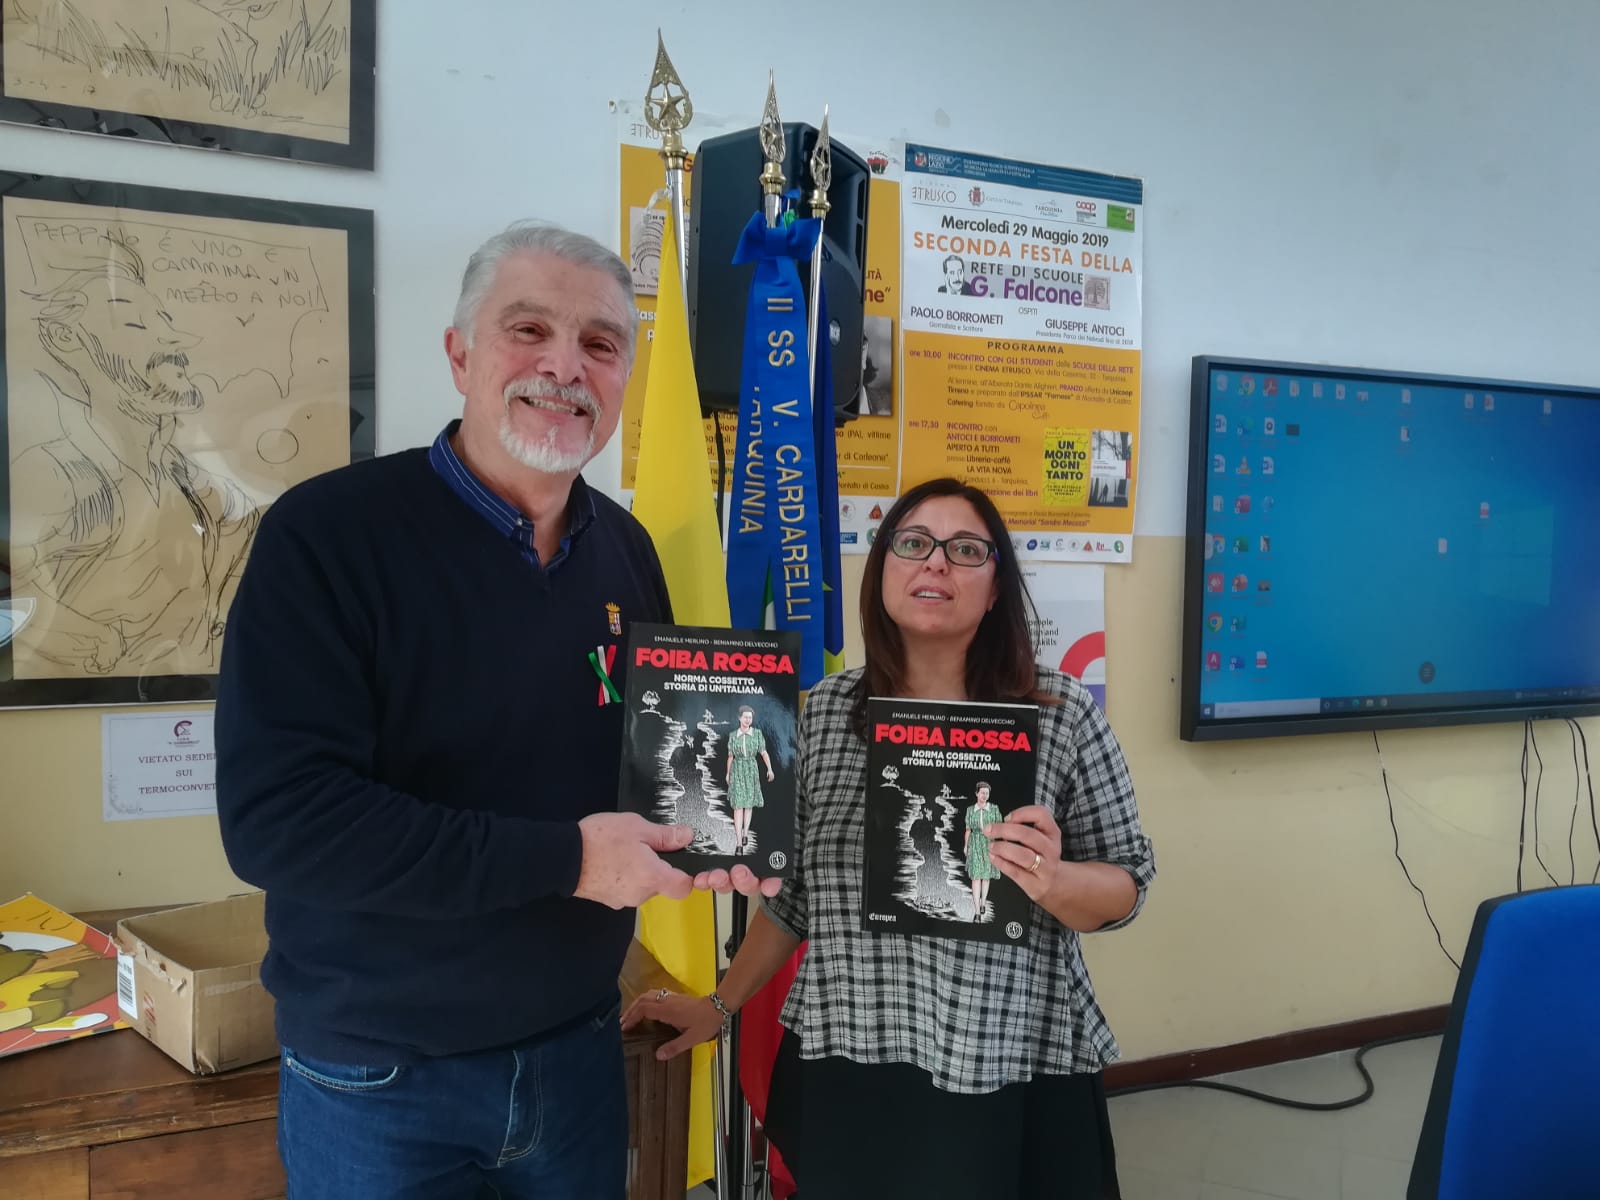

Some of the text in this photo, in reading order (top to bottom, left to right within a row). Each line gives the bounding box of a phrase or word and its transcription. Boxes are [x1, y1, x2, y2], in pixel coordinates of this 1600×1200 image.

[941, 214, 1109, 248] Mercoledì 29 Maggio 2019
[914, 231, 1134, 273] SECONDA FESTA DELLA
[970, 261, 1084, 286] RETE DI SCUOLE
[970, 275, 1082, 306] G. Falcone
[250, 291, 264, 303] A
[910, 306, 1003, 325] PAOLO BORROMETI
[1045, 318, 1124, 336] GIUSEPPE ANTOCI
[768, 329, 796, 367] SS
[987, 341, 1064, 354] PROGRAMMA
[923, 350, 942, 360] 10,00
[948, 352, 984, 362] INCONTRO
[987, 355, 1004, 364] CON
[1006, 356, 1018, 364] GLI
[1020, 358, 1054, 366] STUDENTI
[1072, 362, 1096, 370] SCUOLE
[1098, 364, 1116, 372] DELLA
[1118, 366, 1134, 374] RETE
[974, 364, 1000, 372] CINEMA
[771, 400, 799, 428] V.
[946, 422, 984, 432] INCONTRO
[946, 433, 972, 442] ANTOCI
[980, 434, 1020, 444] BORROMETI
[946, 444, 972, 452] APERTO
[1058, 440, 1074, 450] UN
[844, 452, 850, 460] di
[1044, 450, 1086, 460] MORTO
[992, 466, 1012, 474] NOVA
[1050, 460, 1080, 470] OGNI
[1046, 470, 1084, 480] TANTO
[1012, 488, 1024, 496] dei
[775, 445, 812, 621] CARDARELLI
[654, 636, 684, 644] EMANUELE
[636, 647, 794, 674] FOIBA ROSSA
[674, 674, 755, 686] NORMA COSSETTO
[664, 682, 696, 692] STORIA
[709, 685, 764, 695] UN'ITALIANA
[892, 712, 921, 720] EMANUELE
[980, 718, 1016, 726] DELVECCHIO
[875, 723, 1032, 752] FOIBA ROSSA
[138, 754, 182, 764] VIETATO
[912, 750, 992, 762] NORMA COSSETTO
[902, 757, 1000, 772] STORIA DI UN'ITALIANA
